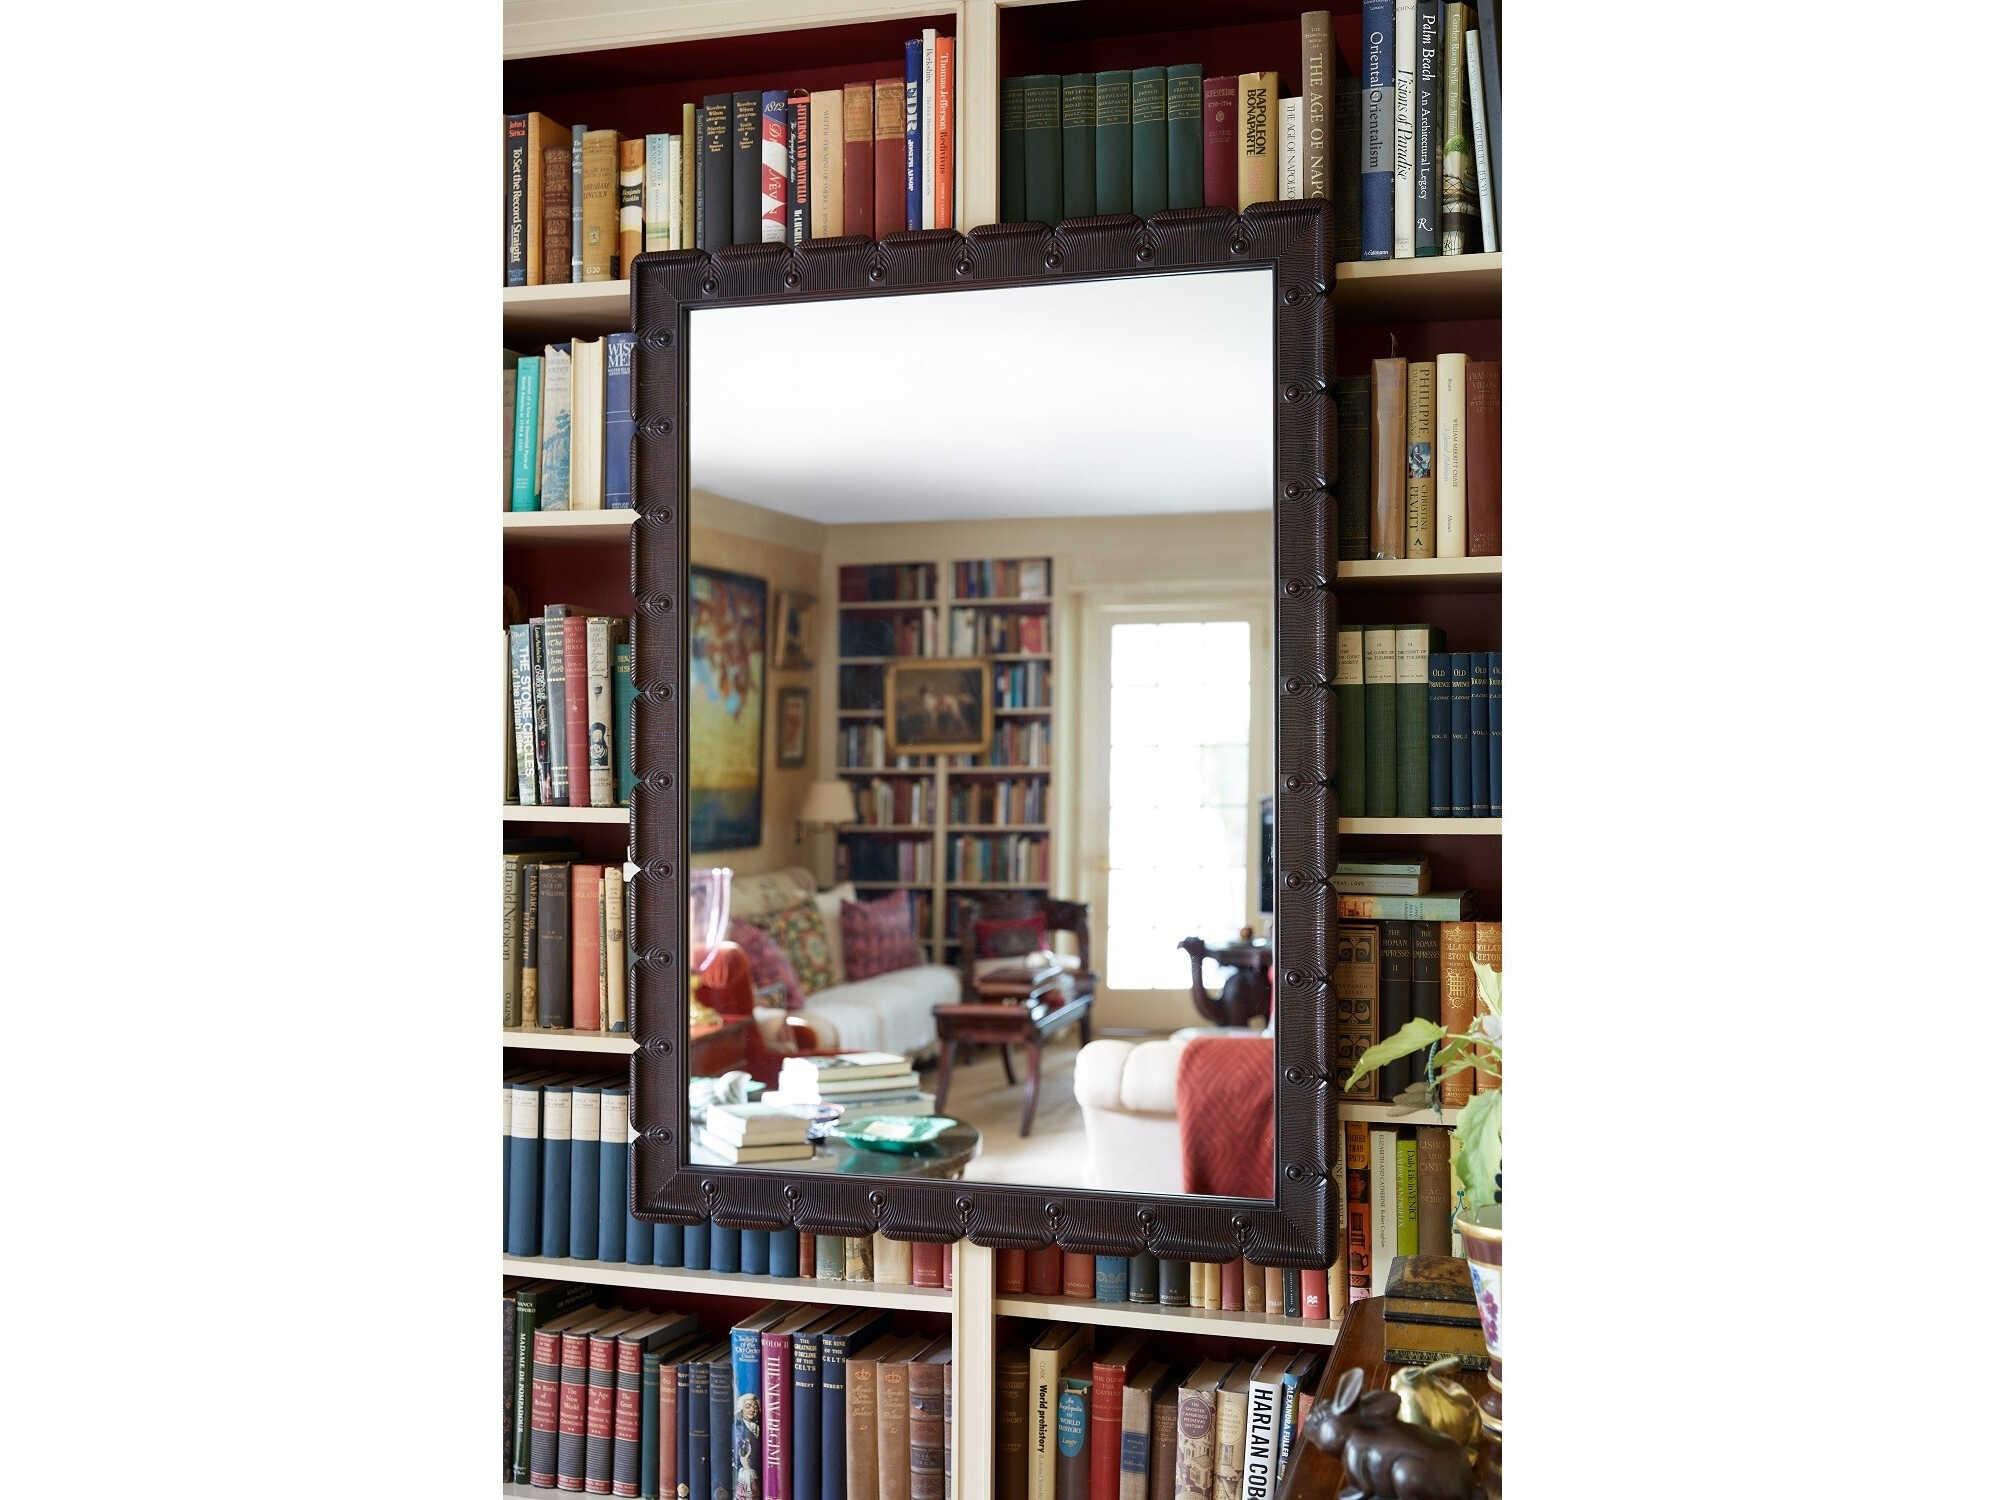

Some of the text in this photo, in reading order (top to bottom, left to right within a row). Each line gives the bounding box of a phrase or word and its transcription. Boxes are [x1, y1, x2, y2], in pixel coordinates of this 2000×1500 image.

[1452, 14, 1460, 41] Garden
[925, 48, 934, 82] Berkshire
[940, 52, 950, 87] Thomas
[1450, 44, 1459, 66] Room
[764, 100, 785, 112] 1812
[906, 81, 918, 133] FDR
[940, 87, 949, 129] Jefferson
[1246, 89, 1256, 156] BONAPARTE
[1256, 88, 1266, 156] NAPOLEON
[1418, 14, 1436, 200] Palm Beach An Architectural Legacy
[1310, 52, 1324, 198] THE AGE OF NAPO
[1370, 90, 1382, 168] Orientalism
[1396, 69, 1414, 180] Visions of Paradise
[512, 158, 522, 174] Set
[513, 147, 523, 158] To
[797, 104, 807, 204] JEFFERSON AND MONTICELLO
[939, 132, 948, 174] Redivivus
[1286, 104, 1296, 200] THE AGE OF NAPOLEO
[512, 174, 522, 190] the
[512, 190, 522, 223] Record
[510, 224, 521, 263] Straight
[512, 668, 518, 678] of
[512, 679, 520, 698] the
[1454, 668, 1466, 676] OLD
[514, 700, 522, 726] British
[518, 648, 534, 778] THE STONE CIRCLES
[504, 860, 520, 961] Harold Nicolson
[530, 875, 538, 912] FANFARE
[1406, 1150, 1415, 1168] Daily
[1408, 1170, 1416, 1182] Life
[1408, 1190, 1418, 1222] VENICE
[520, 1370, 525, 1382] DE
[794, 1364, 816, 1372] CELTS
[822, 1356, 846, 1364] CELTS
[517, 1383, 525, 1433] POMPADOUR
[768, 1356, 780, 1468] THE NEW REGIME
[1037, 1385, 1048, 1453] World prehistory
[1060, 1418, 1081, 1426] WORLD
[1282, 1384, 1295, 1458] ALEXANDRA FULLER
[1059, 1426, 1082, 1434] HISTORY
[1246, 1388, 1274, 1500] HARLAN COB
